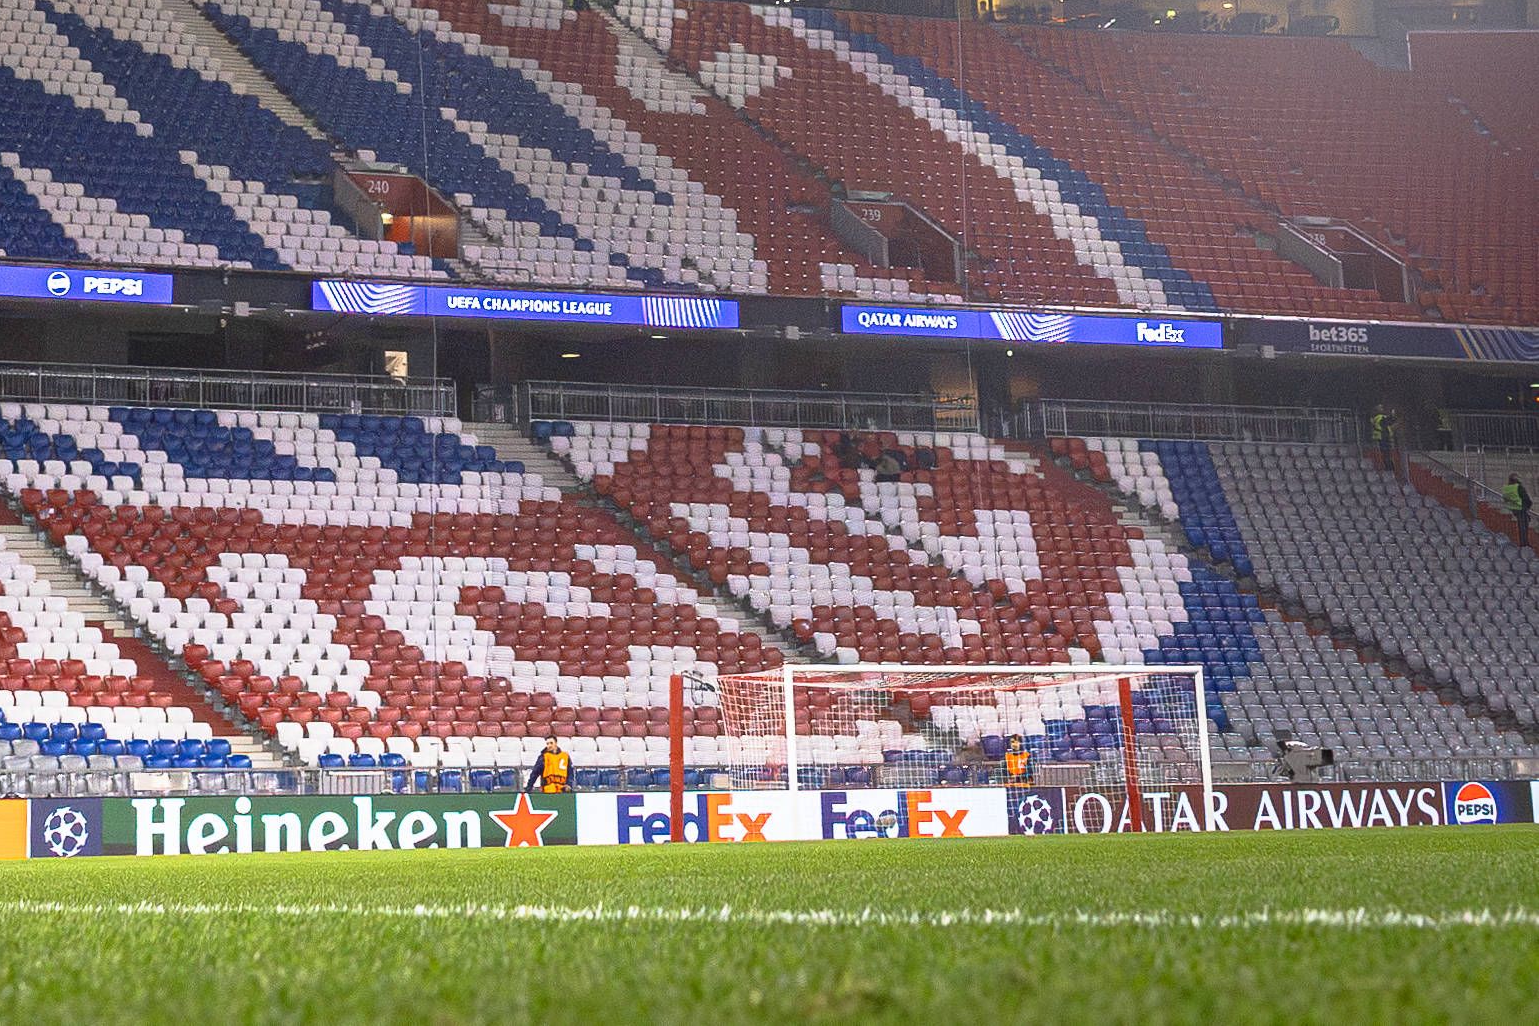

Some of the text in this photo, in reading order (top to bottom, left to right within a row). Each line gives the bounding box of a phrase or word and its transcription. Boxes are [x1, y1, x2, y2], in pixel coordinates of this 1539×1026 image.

[367, 180, 390, 194] 240
[861, 208, 881, 222] 239
[83, 276, 143, 296] PEPSI
[447, 295, 612, 316] UEFA CHAMPIONS LEAGUE
[858, 312, 958, 329] QATAR AIRWAYS
[1136, 322, 1185, 343] FedEx
[1309, 324, 1368, 343] bet365
[616, 793, 772, 845] FedEx
[820, 790, 969, 840] FedEx
[1254, 787, 1437, 832] AIRWAYS
[1457, 803, 1494, 816] PEPSI
[131, 796, 481, 855] Heineken
